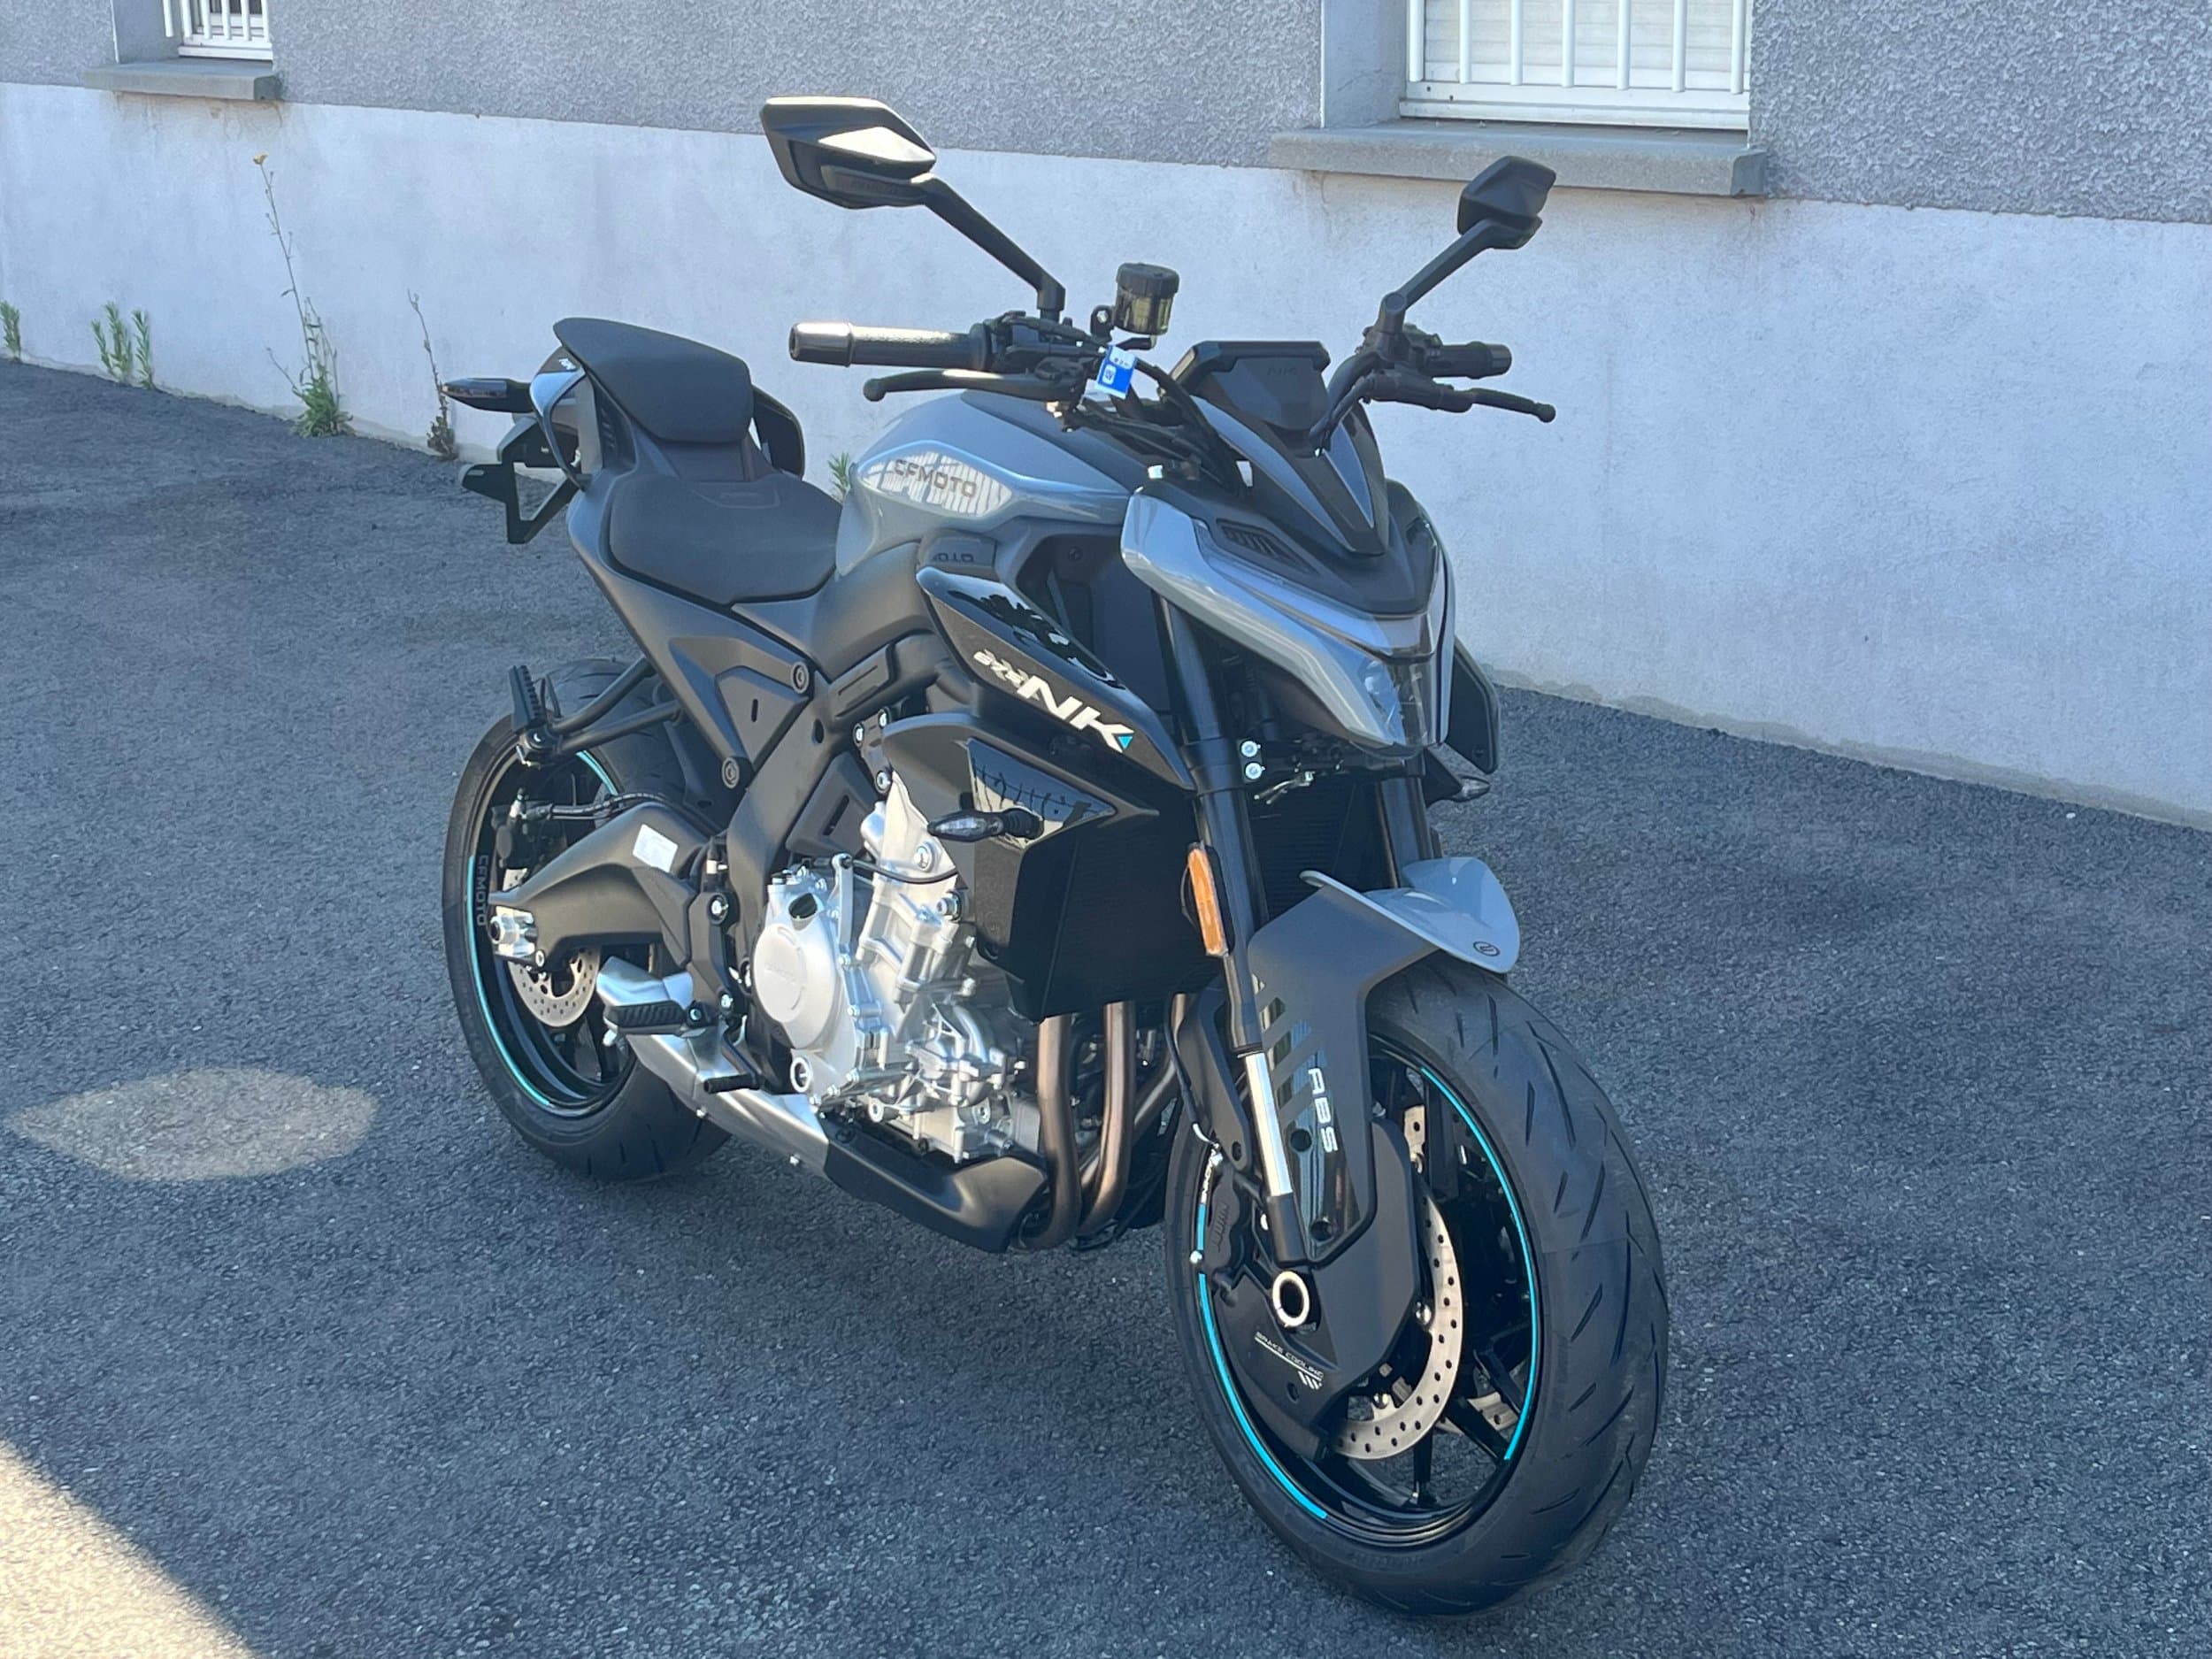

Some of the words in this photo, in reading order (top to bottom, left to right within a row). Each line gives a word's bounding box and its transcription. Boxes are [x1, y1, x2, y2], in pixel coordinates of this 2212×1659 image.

[895, 458, 978, 497] CFMOTO
[1017, 675, 1135, 753] NK
[476, 855, 489, 926] CFMOTO
[1308, 1068, 1339, 1153] ABS
